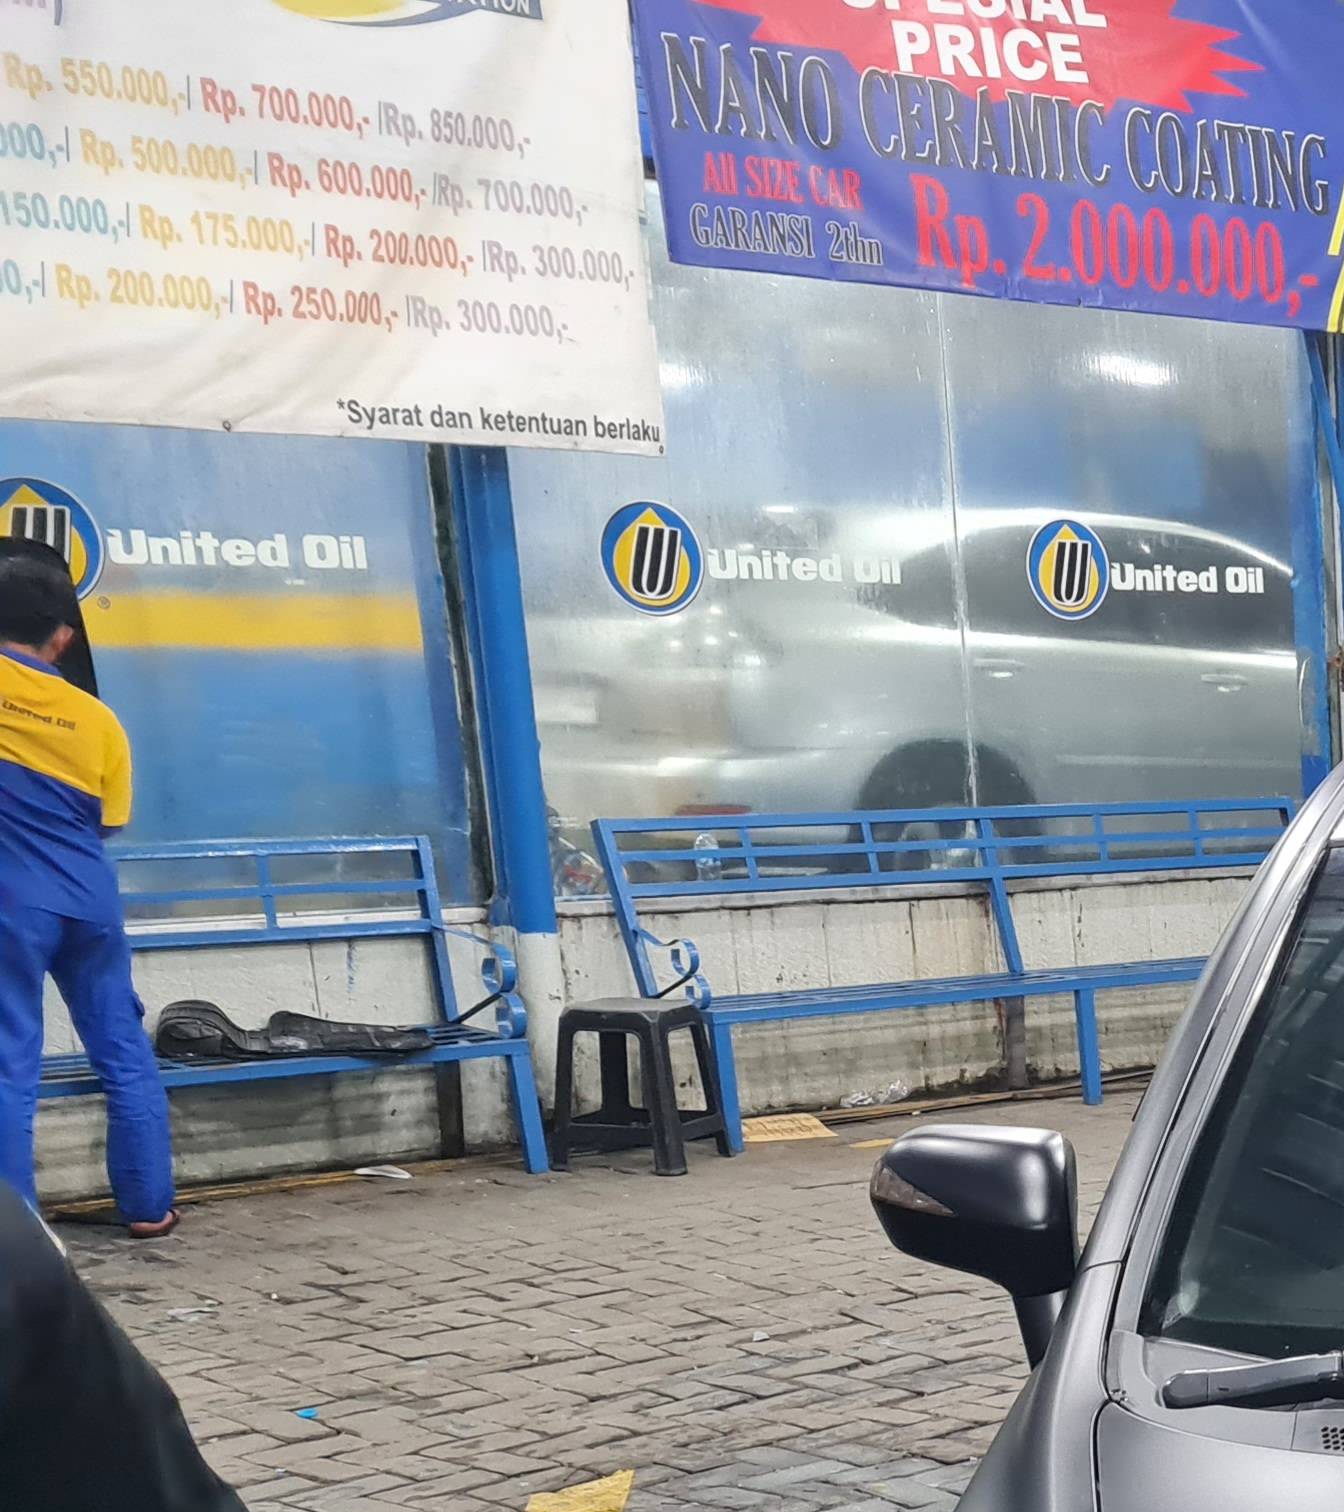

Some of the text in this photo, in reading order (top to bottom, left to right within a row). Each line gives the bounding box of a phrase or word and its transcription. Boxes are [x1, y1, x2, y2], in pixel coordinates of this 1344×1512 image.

[891, 19, 1089, 83] PRICE
[3, 51, 53, 101] Rp.
[199, 76, 246, 124] Rp.
[660, 31, 1330, 216] NANO CERAMIC COATING
[79, 127, 125, 175] Rp.
[266, 151, 311, 198] Rp.
[744, 155, 805, 204] SIZE
[808, 164, 864, 211] CAR
[138, 203, 184, 251] Rp.
[323, 223, 363, 268] Rp.
[689, 202, 884, 267] GARANSI 2thn
[909, 172, 1320, 317] Rp. 2.000.000,-
[54, 262, 101, 310] Rp.
[242, 280, 284, 325] Rp.
[429, 404, 474, 431] dan
[479, 406, 588, 438] ketentuan
[593, 415, 661, 443] berlaku
[106, 527, 368, 570] United Oil
[707, 548, 902, 585] United Oil
[1111, 562, 1265, 594] United Oil
